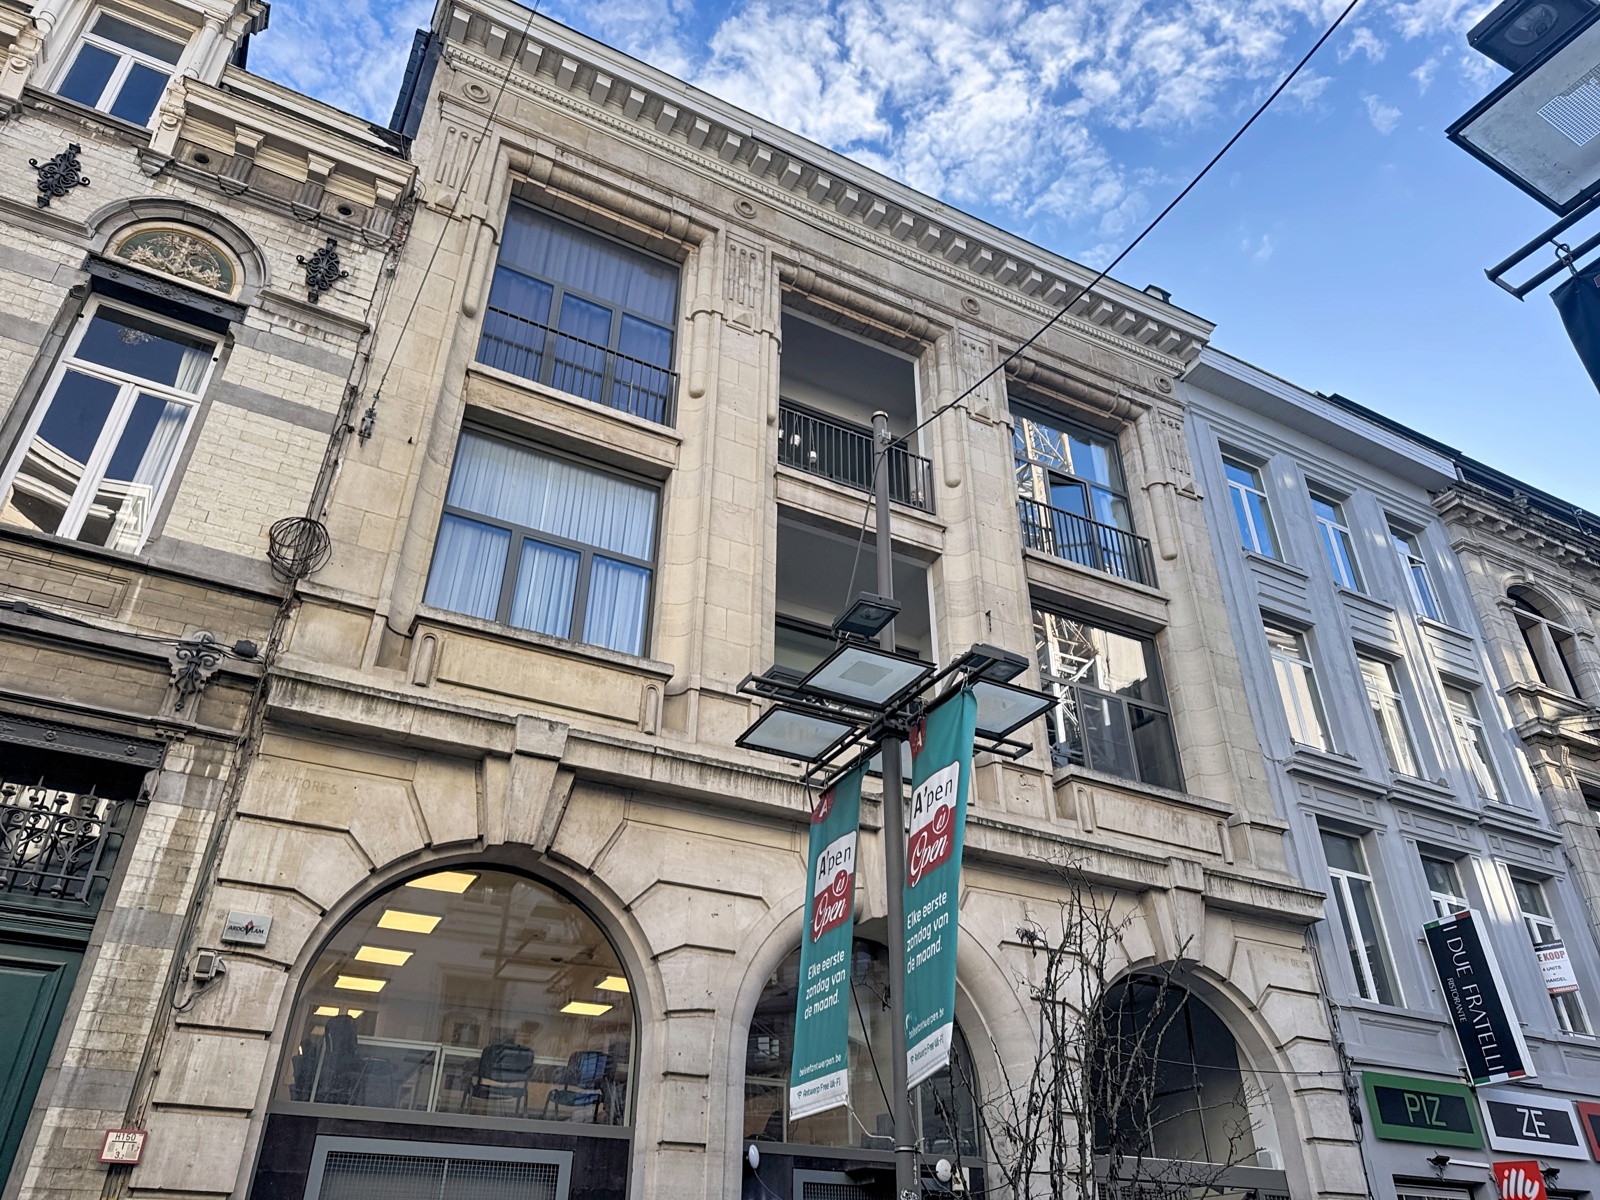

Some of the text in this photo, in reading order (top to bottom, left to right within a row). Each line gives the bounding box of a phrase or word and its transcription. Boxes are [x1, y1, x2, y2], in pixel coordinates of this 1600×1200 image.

[911, 831, 949, 888] Open
[814, 892, 847, 943] Open
[907, 891, 948, 930] Elke eerste
[906, 912, 949, 953] zondag van
[808, 950, 845, 980] Elke eerste
[907, 934, 943, 975] de maand.
[1543, 950, 1566, 962] KOOP
[806, 969, 846, 1001] zondag van
[1447, 977, 1468, 1023] RISTORANTE
[804, 988, 840, 1020] de maand.
[1446, 936, 1474, 979] DUE
[1462, 983, 1505, 1072] FRATELLI
[1403, 1092, 1447, 1127] PIZ
[1516, 1107, 1550, 1139] ZE
[1502, 1168, 1540, 1200] illy
